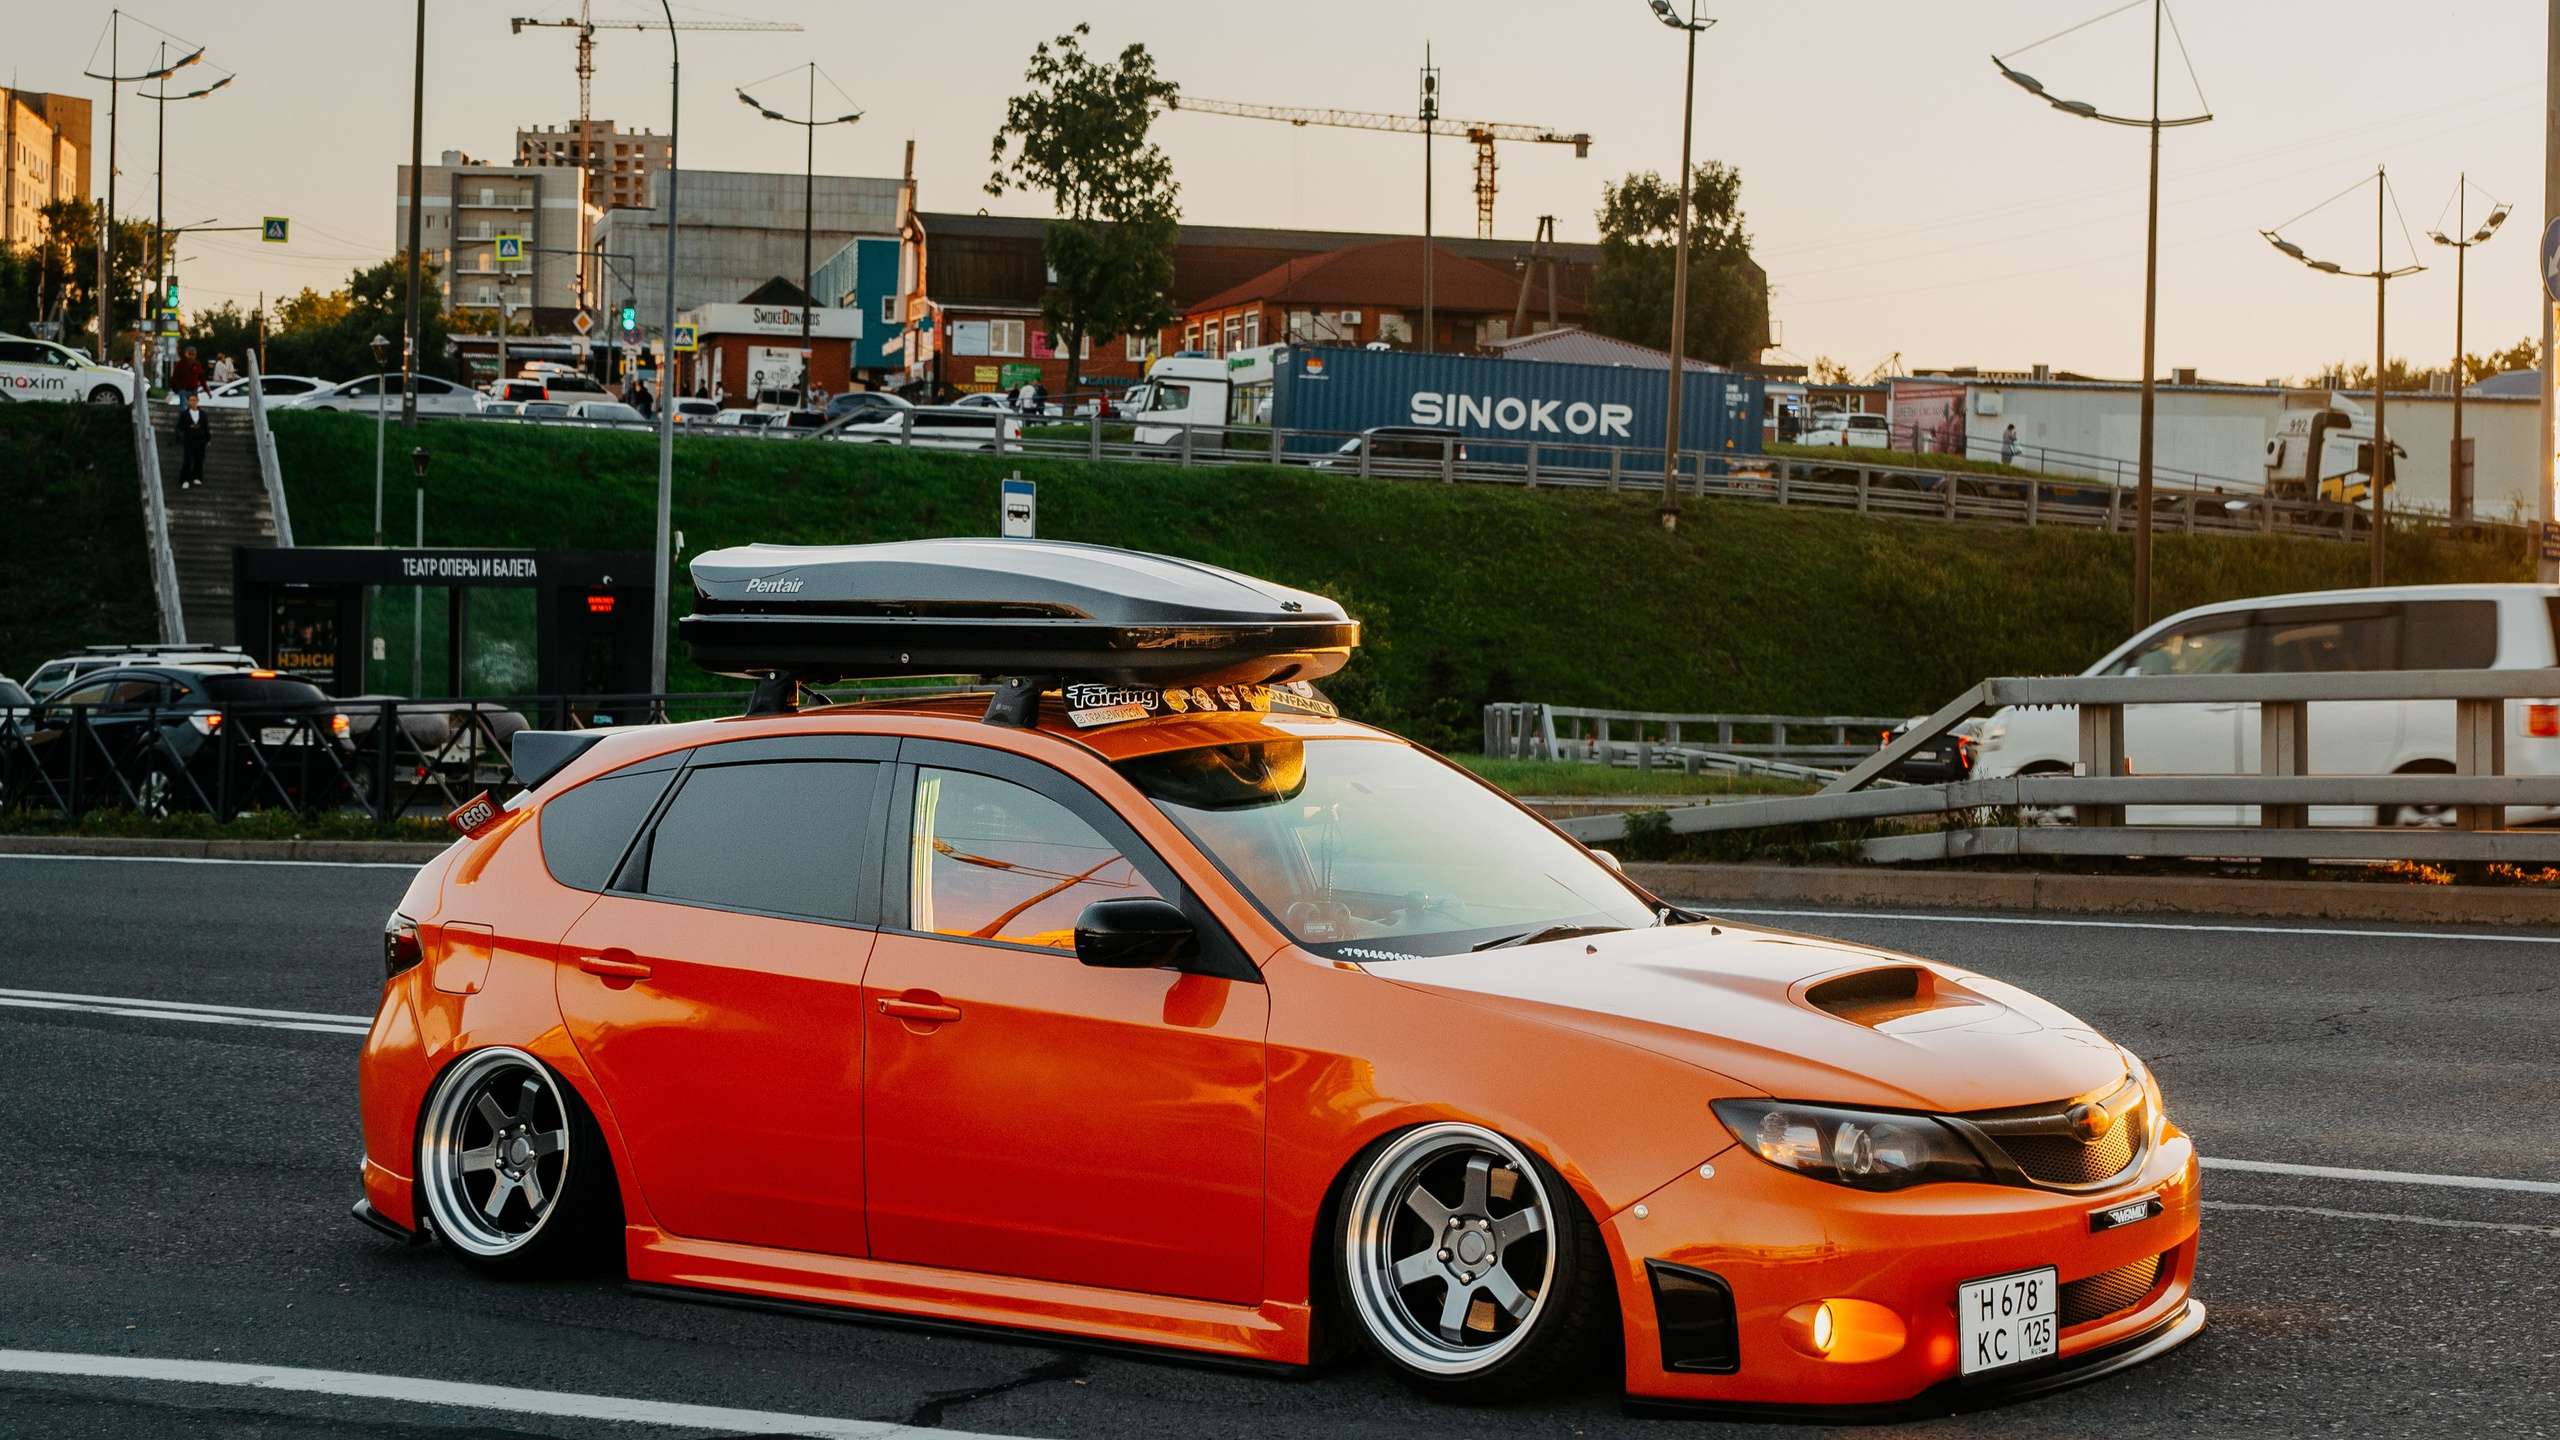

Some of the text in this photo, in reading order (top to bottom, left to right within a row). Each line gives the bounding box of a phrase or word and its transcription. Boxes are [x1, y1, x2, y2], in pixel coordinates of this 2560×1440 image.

[754, 308, 821, 326] SMOKEDONADS
[0, 374, 64, 390] maxim
[1411, 391, 1633, 438] SINOKOR
[2289, 419, 2308, 432] 992
[402, 558, 538, 578] ТЕАТР ОПЕРЫ И БАЛЕТА
[745, 577, 804, 593] Pentair
[277, 652, 335, 667] НЭНСИ
[1066, 683, 1159, 711] Fairing
[457, 801, 494, 831] LEGO
[2001, 1279, 2038, 1317] 678
[2024, 1318, 2051, 1348] 125
